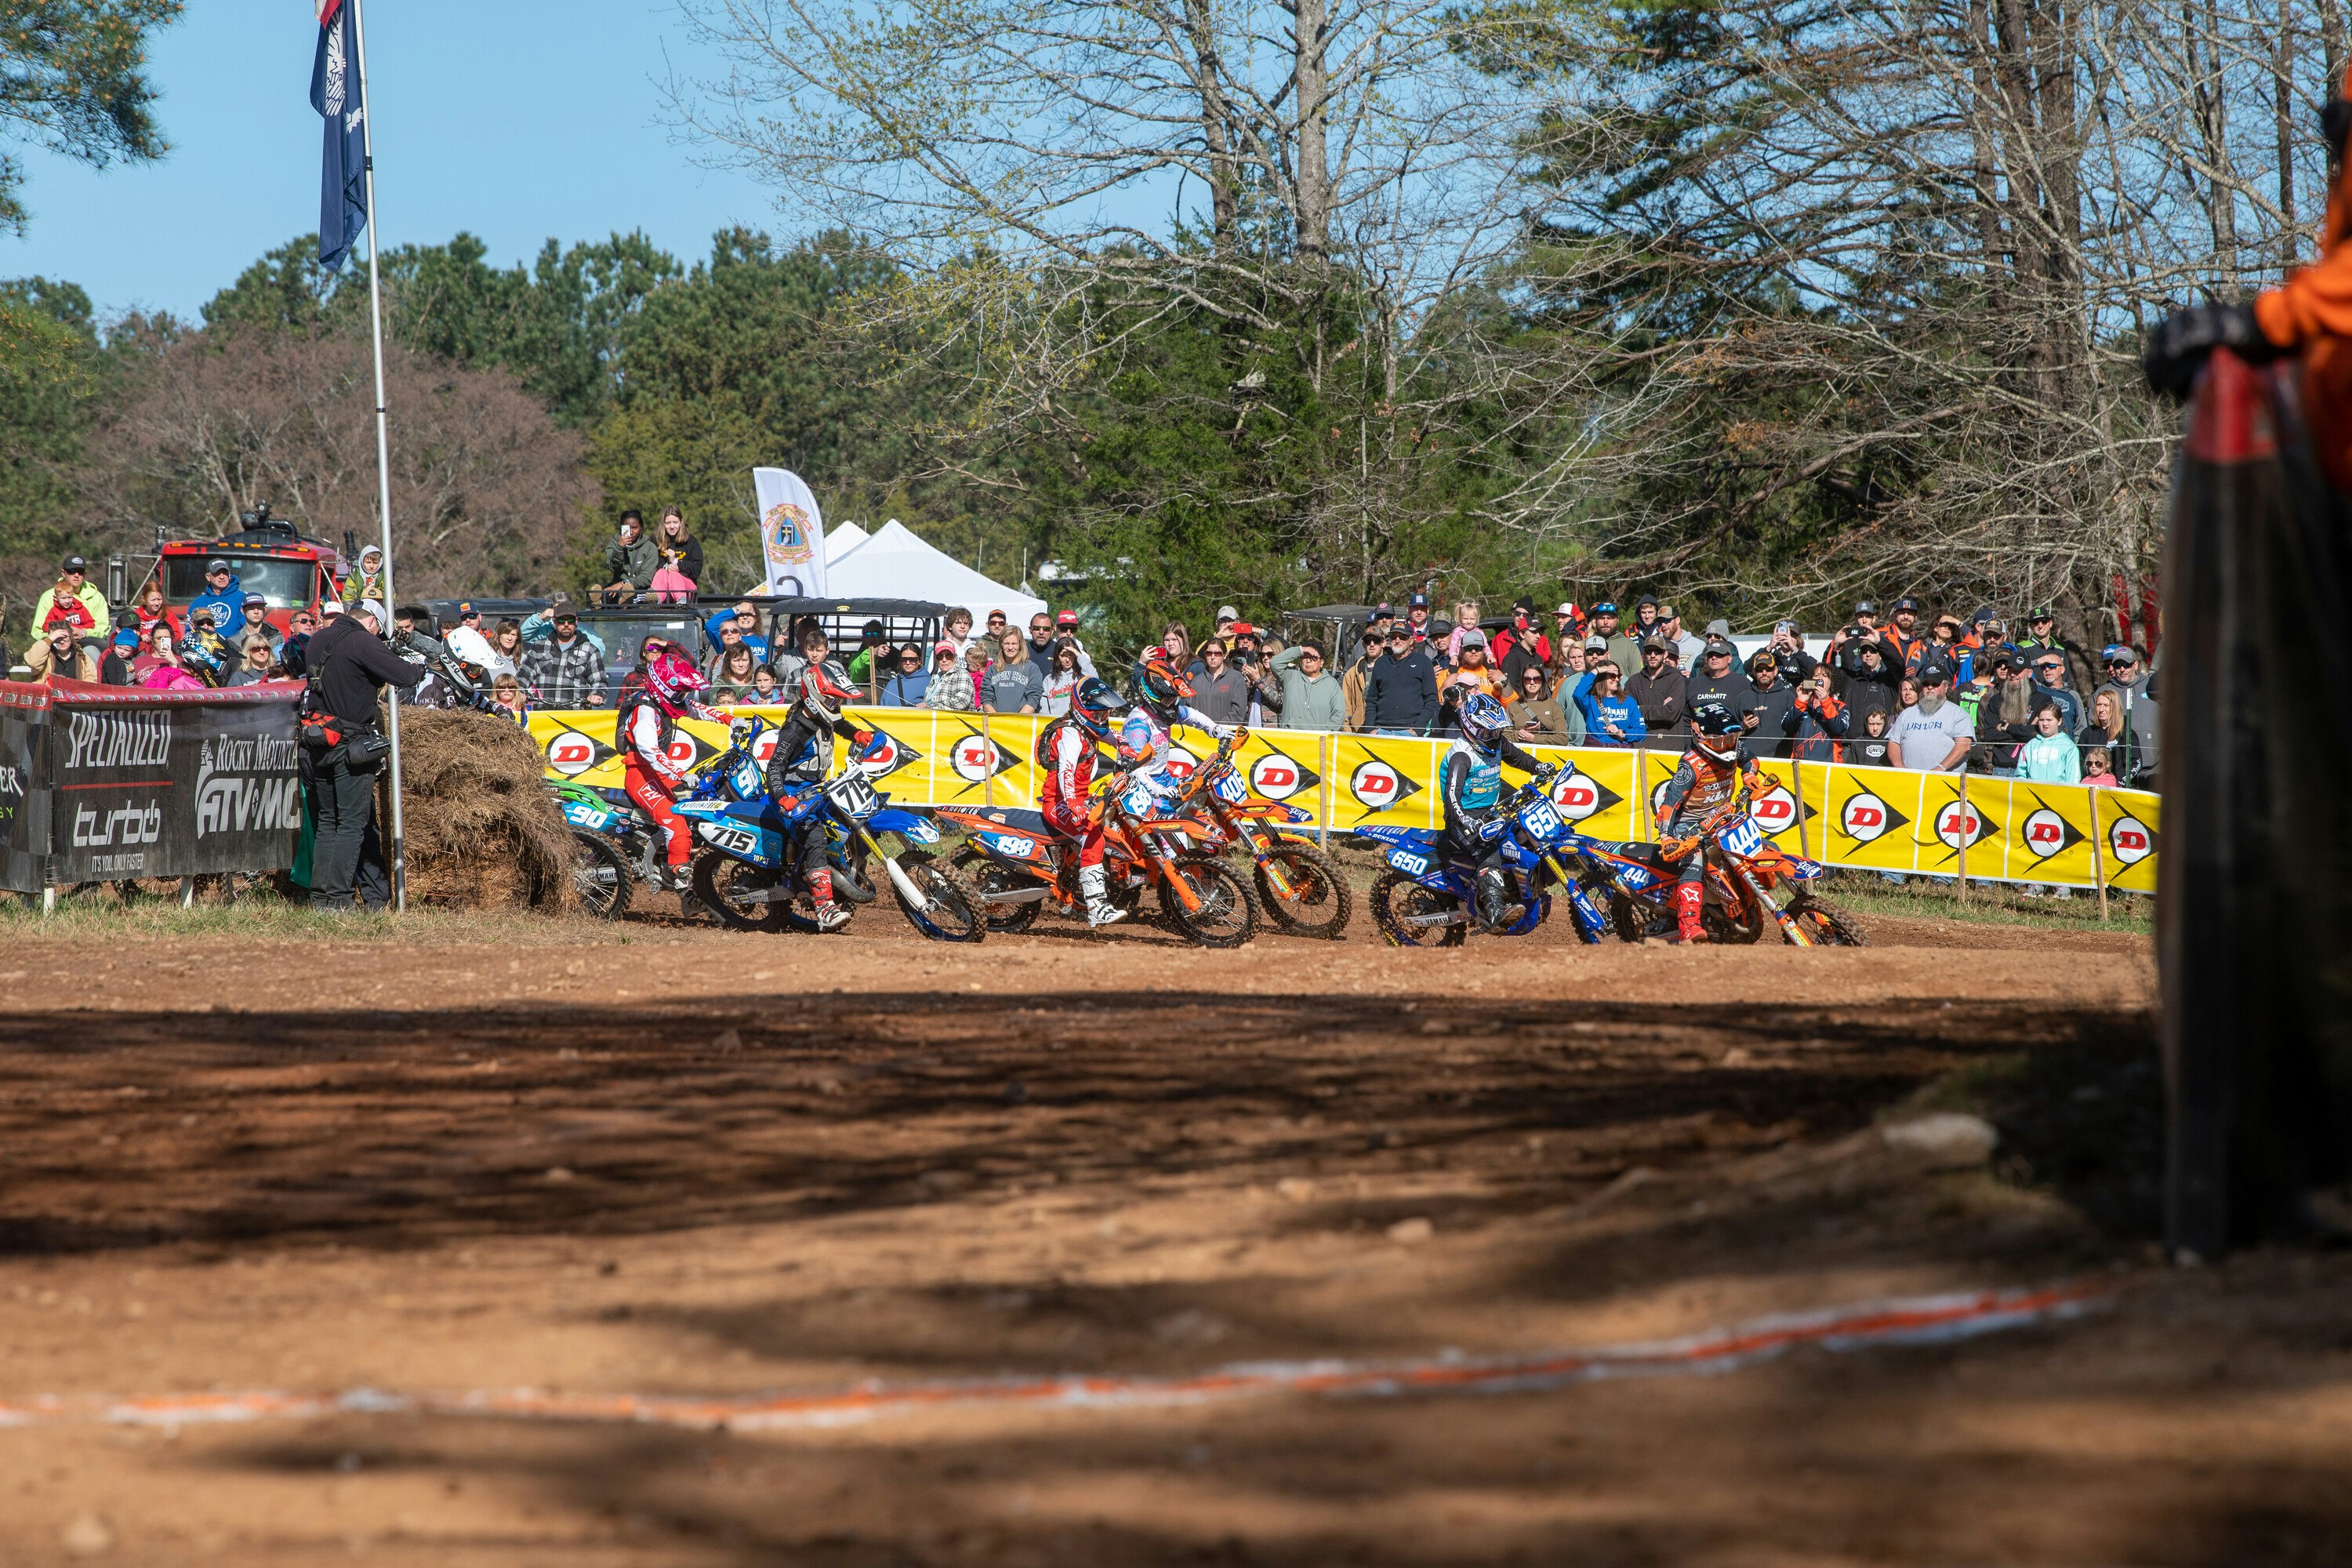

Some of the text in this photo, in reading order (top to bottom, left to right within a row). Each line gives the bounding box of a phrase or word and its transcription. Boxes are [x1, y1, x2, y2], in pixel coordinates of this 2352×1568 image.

[65, 710, 171, 768] SPECIALIZED
[216, 733, 255, 772] ROCKY
[1220, 770, 1247, 803] 406
[1257, 768, 1295, 786] D
[1358, 774, 1394, 793] D
[1127, 786, 1153, 815] 198
[1556, 786, 1595, 806] D
[568, 805, 608, 829] 90
[1754, 799, 1791, 818] D
[1847, 807, 1882, 826] D
[710, 826, 753, 852] 715
[1372, 833, 1399, 844] DUNLOP
[2029, 822, 2060, 843] D
[2117, 830, 2147, 850] D
[996, 835, 1035, 858] 198
[1502, 848, 1521, 860] YAMAHA
[92, 853, 144, 873] IT'S YOU, ONLY FASTER
[1391, 851, 1428, 876] 650
[1624, 866, 1651, 887] 444
[1425, 916, 1454, 926] YAMAHA
[1577, 904, 1598, 924] DUNLOP
